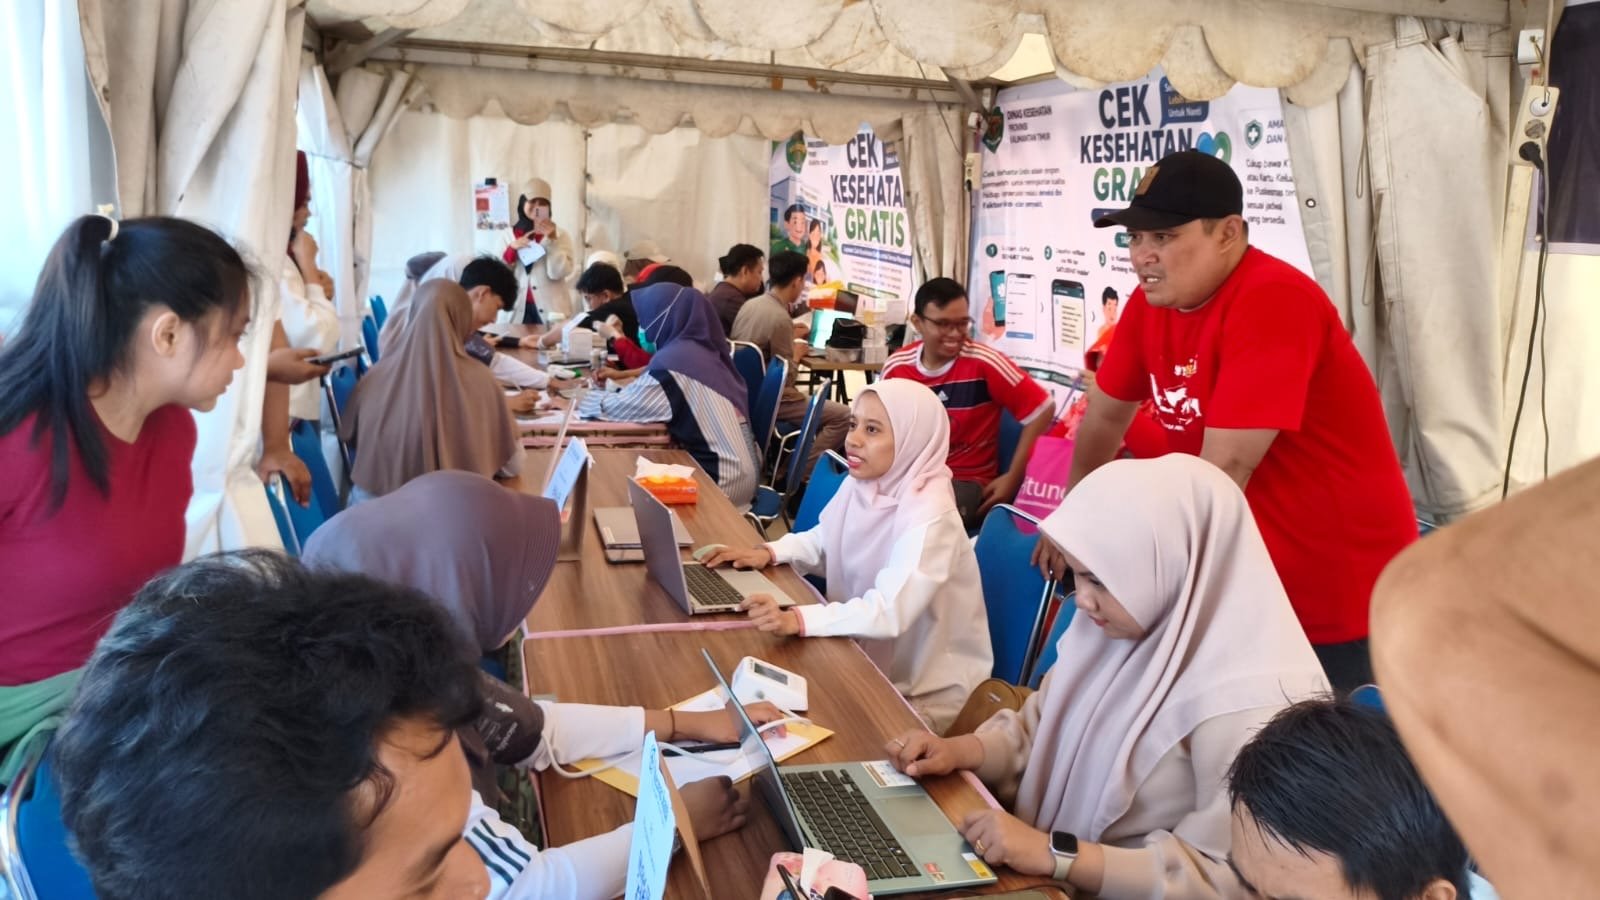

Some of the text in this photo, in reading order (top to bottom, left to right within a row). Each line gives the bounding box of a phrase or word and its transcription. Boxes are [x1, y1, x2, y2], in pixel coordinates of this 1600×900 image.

[1099, 84, 1151, 129] CEK
[1267, 120, 1284, 128] AMA
[846, 133, 879, 169] CEK
[1080, 128, 1192, 164] KESEHATAN
[830, 174, 904, 209] KESEHATA
[1093, 166, 1146, 202] GRA
[845, 208, 905, 248] GRATIS
